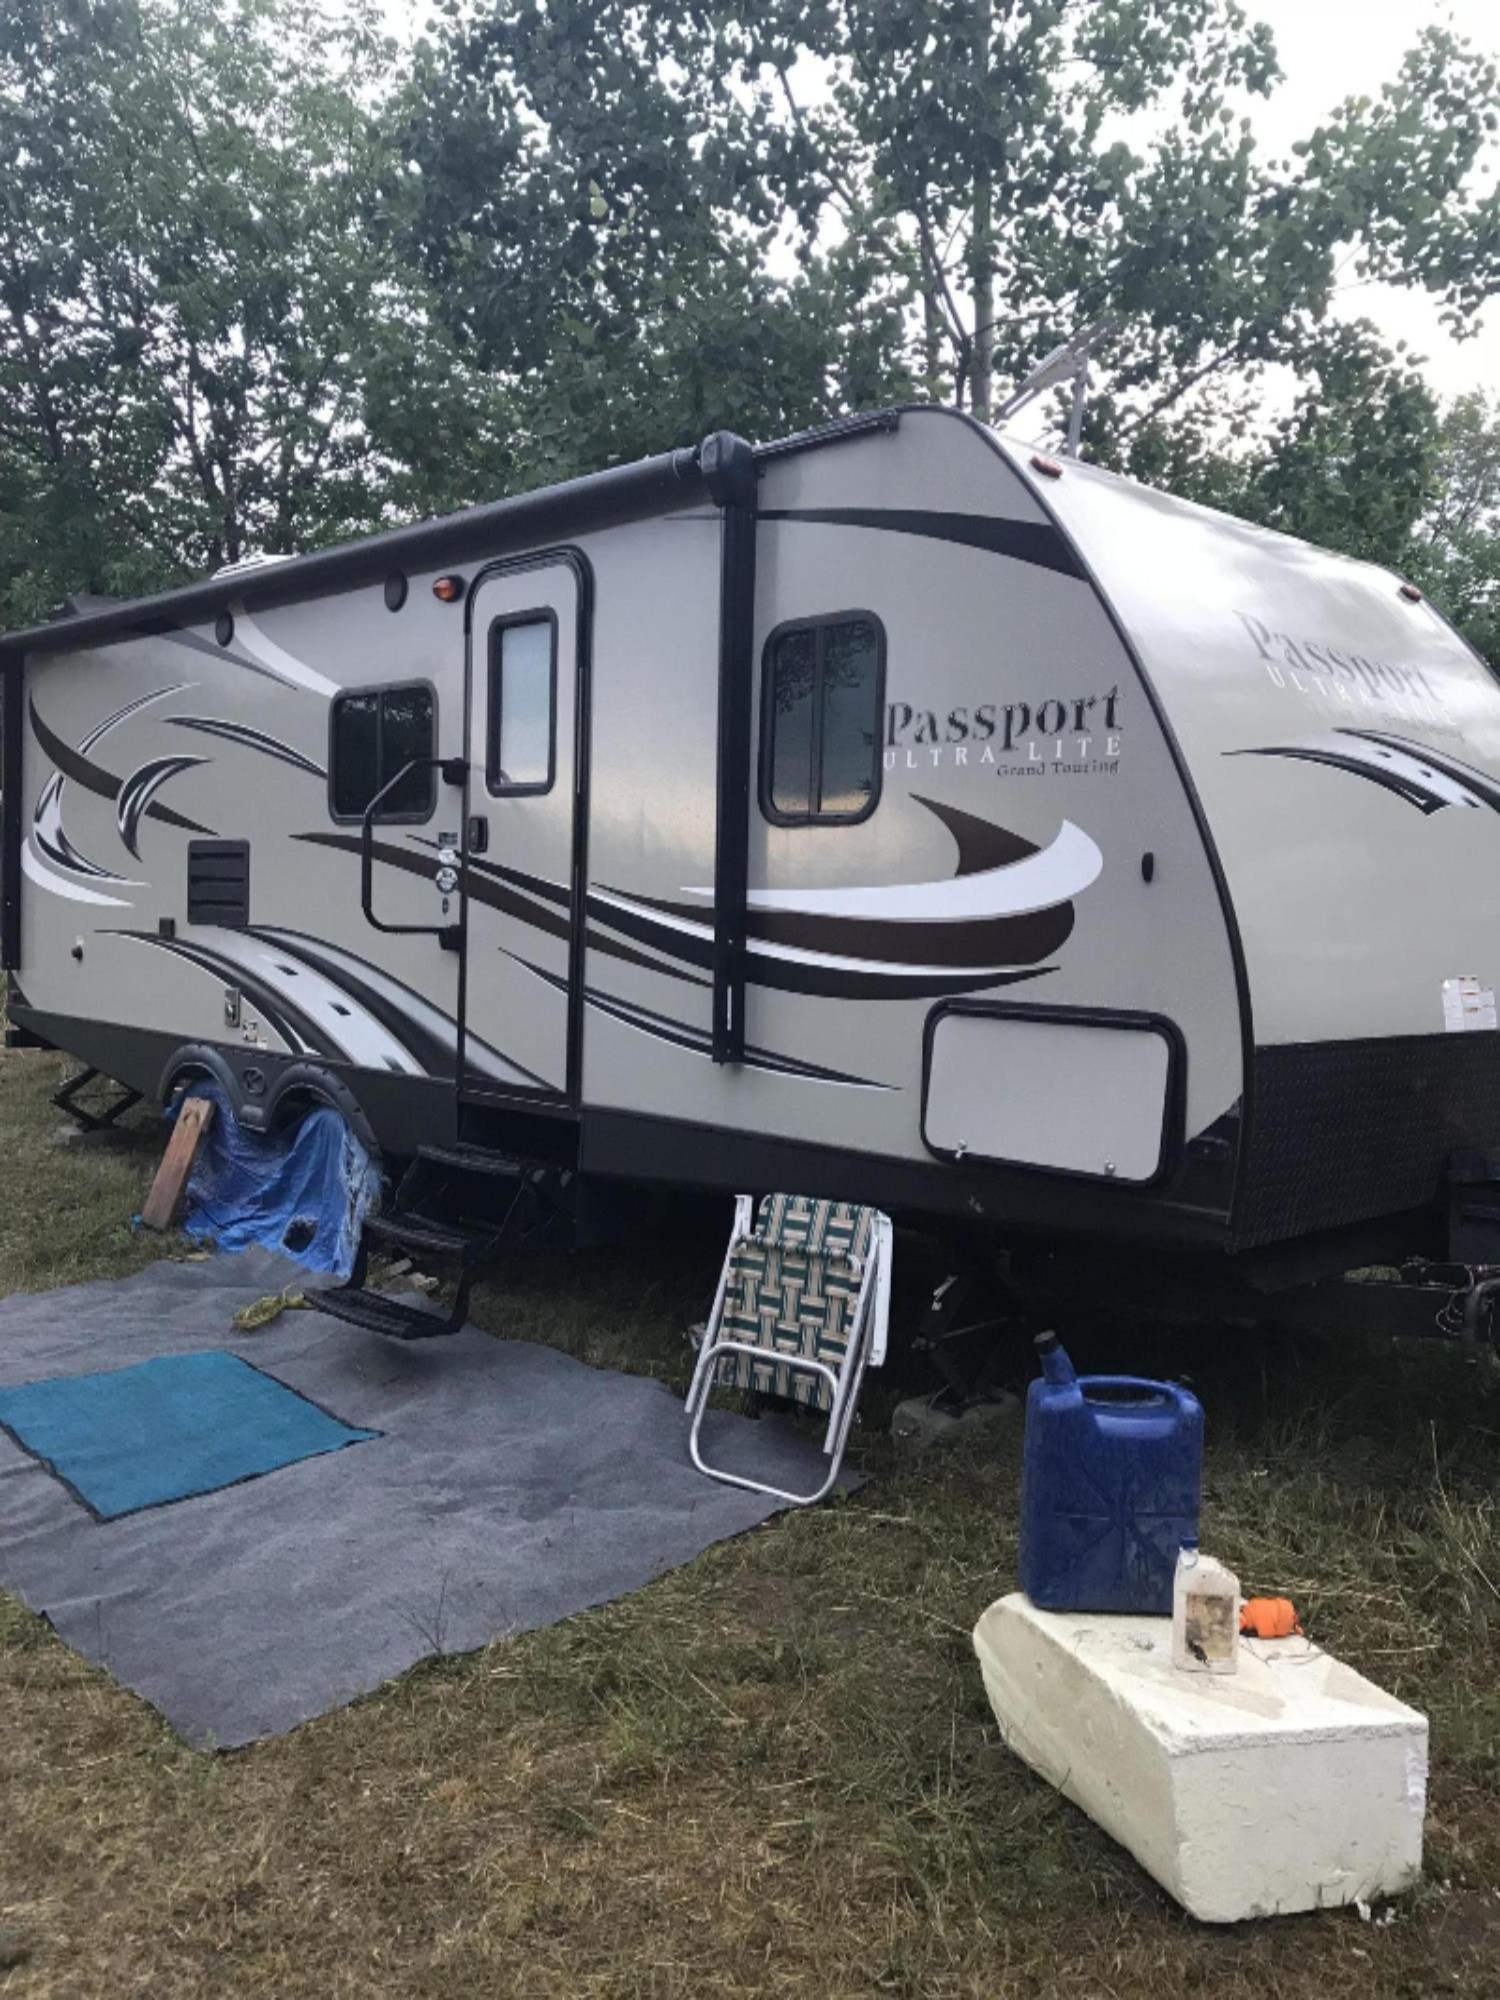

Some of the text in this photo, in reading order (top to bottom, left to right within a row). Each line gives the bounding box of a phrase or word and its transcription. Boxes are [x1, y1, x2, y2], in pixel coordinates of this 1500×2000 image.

[1232, 609, 1444, 702] Passport
[886, 684, 1123, 751] Passport
[883, 735, 1121, 770] ULTRA LITE
[996, 758, 1120, 777] Grand Touring
